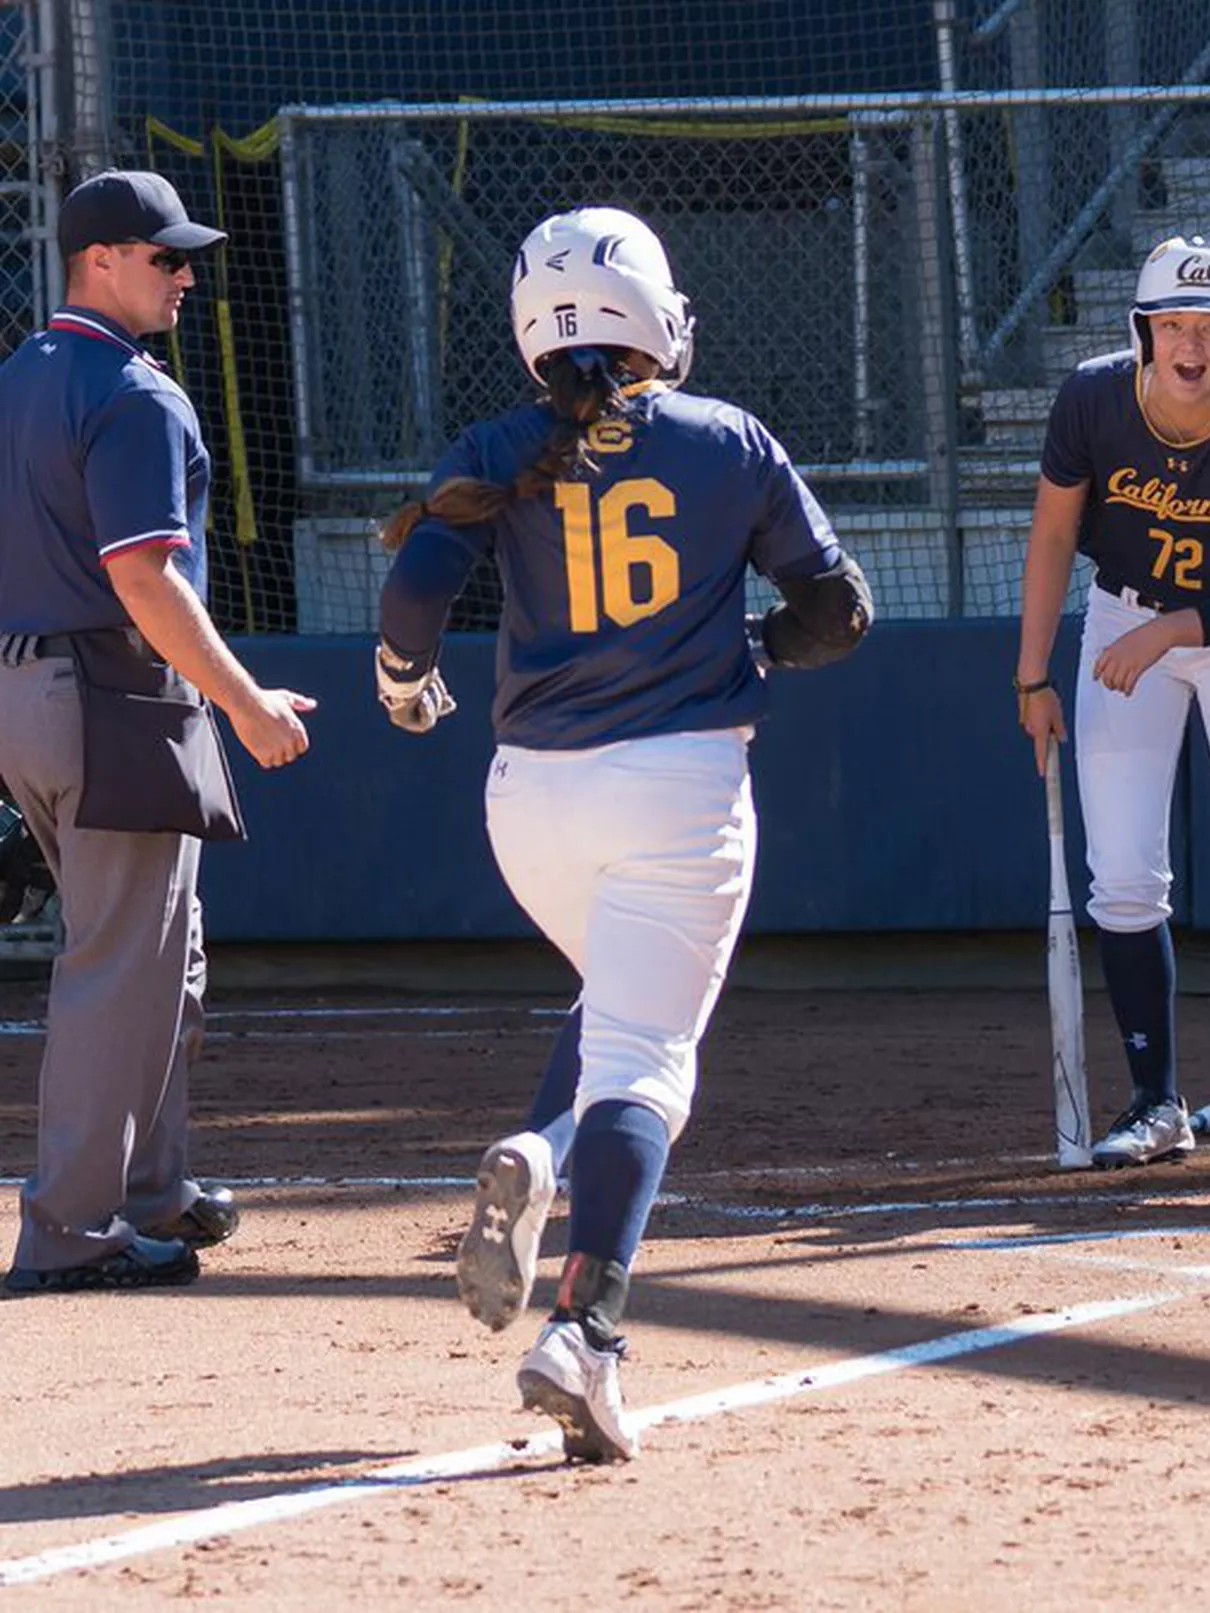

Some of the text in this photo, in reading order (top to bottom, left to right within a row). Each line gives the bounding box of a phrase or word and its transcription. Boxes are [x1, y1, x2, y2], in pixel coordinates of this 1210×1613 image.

[555, 312, 577, 337] 16
[554, 478, 679, 632] 16
[1148, 529, 1204, 590] 72
